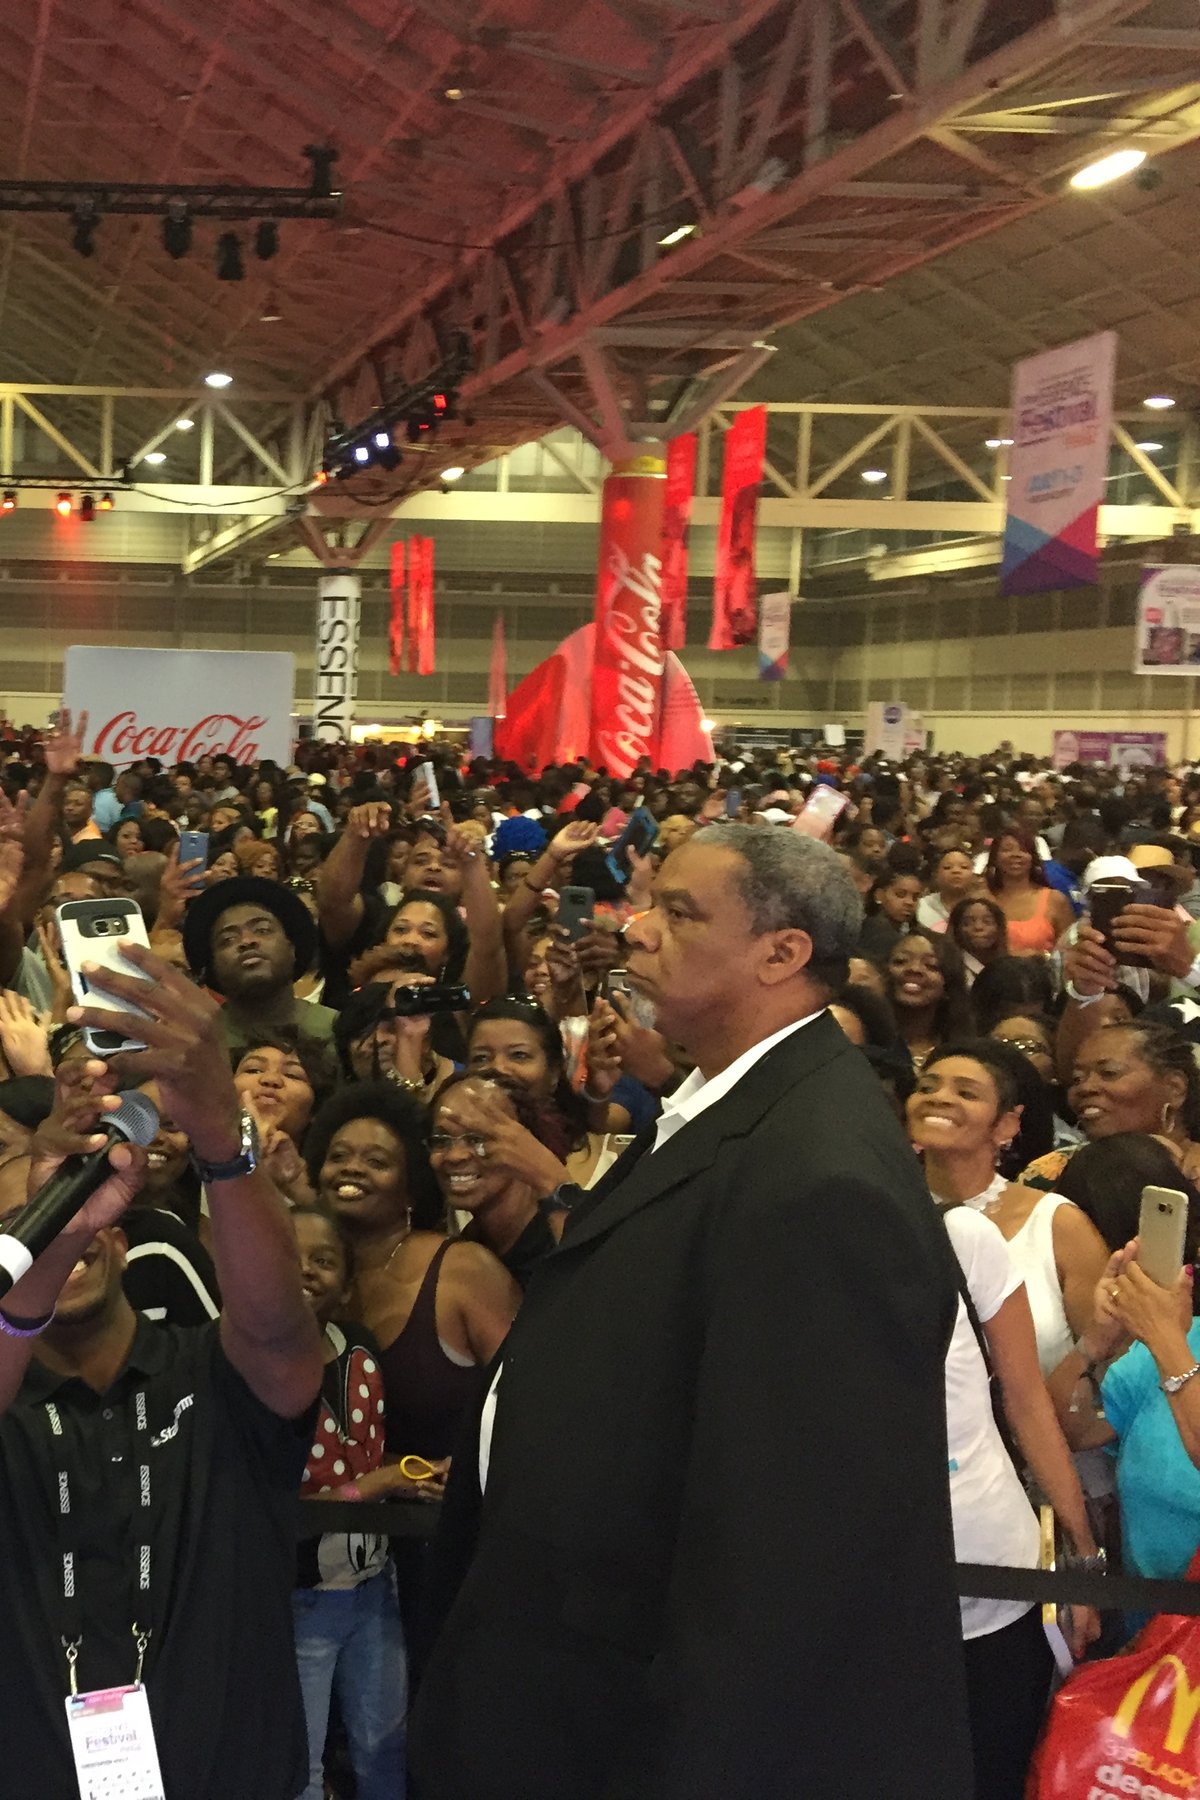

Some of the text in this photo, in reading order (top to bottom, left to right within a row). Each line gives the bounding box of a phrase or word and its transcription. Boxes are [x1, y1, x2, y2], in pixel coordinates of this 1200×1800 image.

[58, 1471, 71, 1514] ESSENCE
[140, 1464, 151, 1507] ESSENCE
[63, 1551, 75, 1598] ESSENCE
[140, 1544, 151, 1590] ESSENCE
[85, 1729, 138, 1750] Festival
